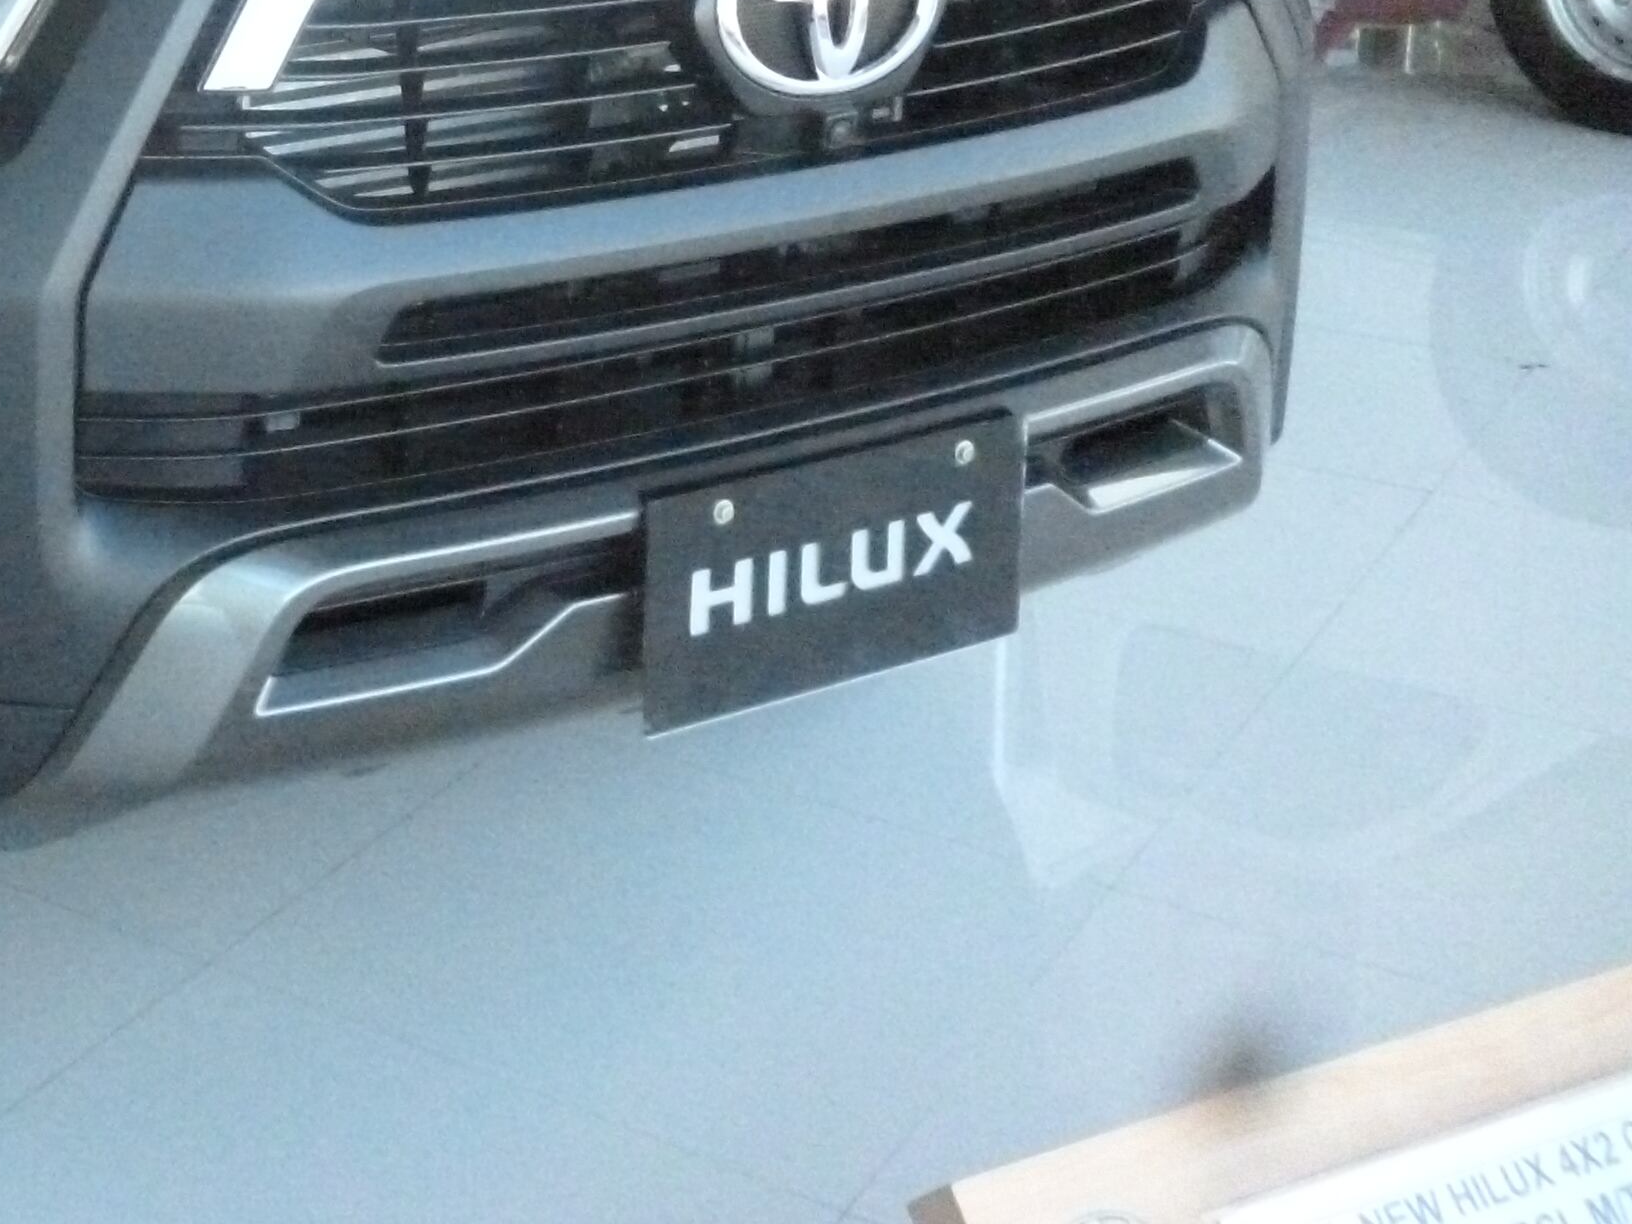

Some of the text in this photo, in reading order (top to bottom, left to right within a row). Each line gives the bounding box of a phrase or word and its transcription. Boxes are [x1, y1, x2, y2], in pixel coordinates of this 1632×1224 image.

[689, 500, 973, 637] HILUX
[1446, 1152, 1557, 1217] HILUX
[1559, 1131, 1621, 1176] 4X2
